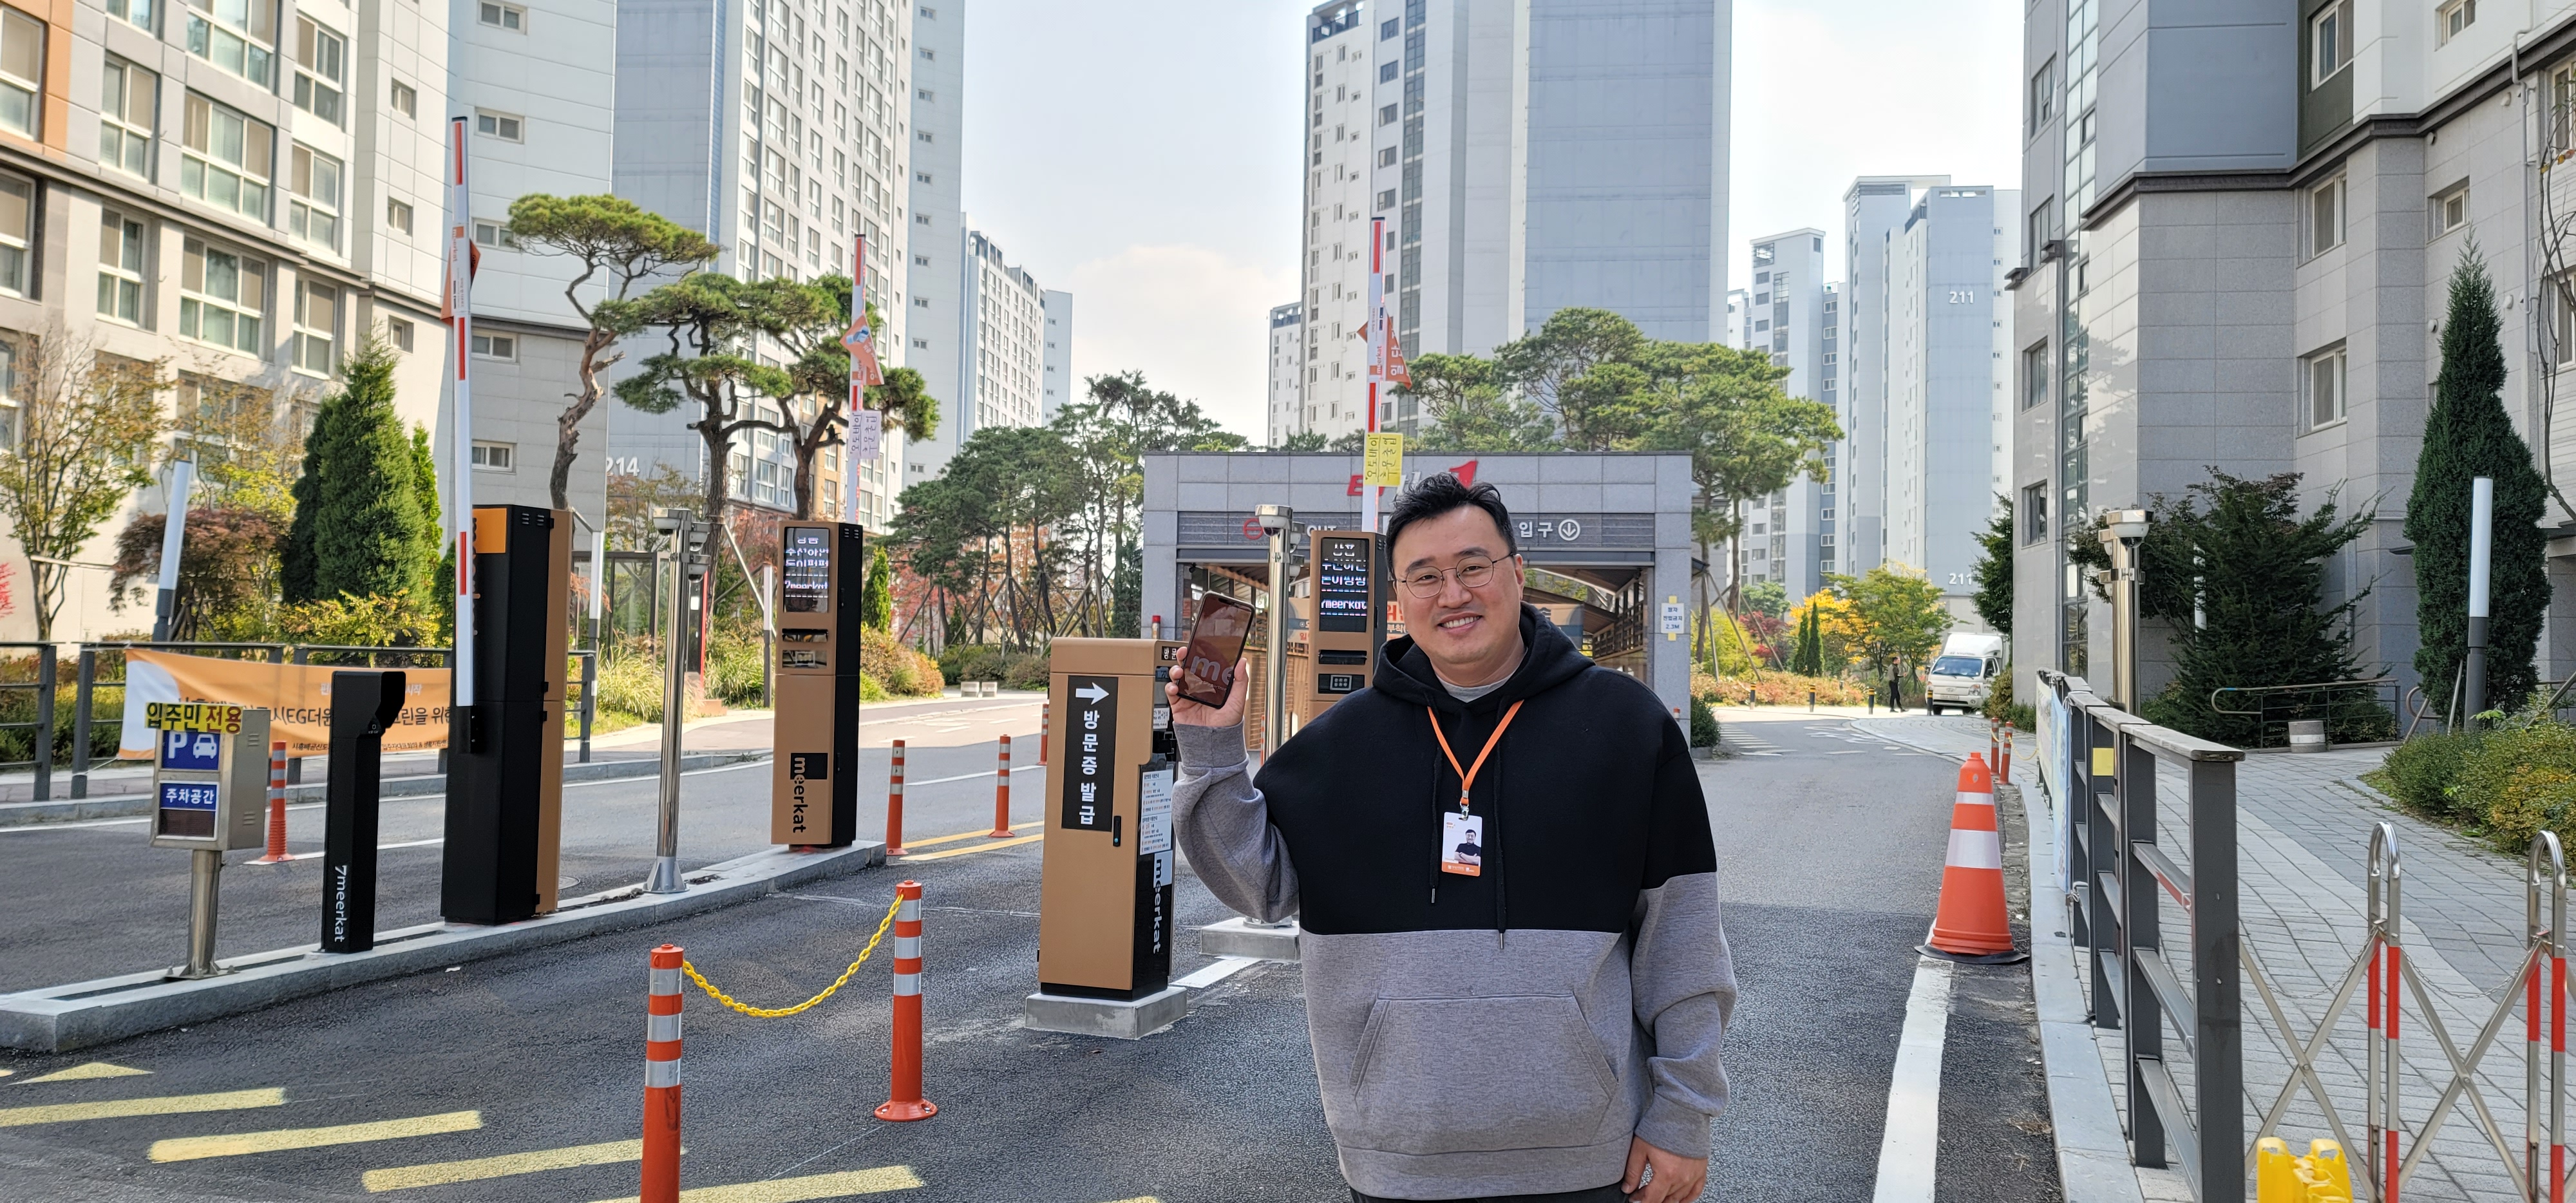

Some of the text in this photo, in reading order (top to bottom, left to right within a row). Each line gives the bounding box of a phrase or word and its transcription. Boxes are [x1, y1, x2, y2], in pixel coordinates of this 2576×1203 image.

[1949, 290, 1974, 304] 211
[607, 457, 639, 477] 214
[1519, 521, 1553, 538] 입구
[1949, 573, 1972, 585] 211
[147, 703, 242, 734] 입주민 전용
[168, 732, 187, 759] P
[1079, 710, 1100, 826] 방문증 발급
[166, 788, 214, 804] 주차공간
[793, 756, 809, 834] meerkat
[334, 864, 348, 943] 7meerkat
[1153, 858, 1162, 954] meerkat
